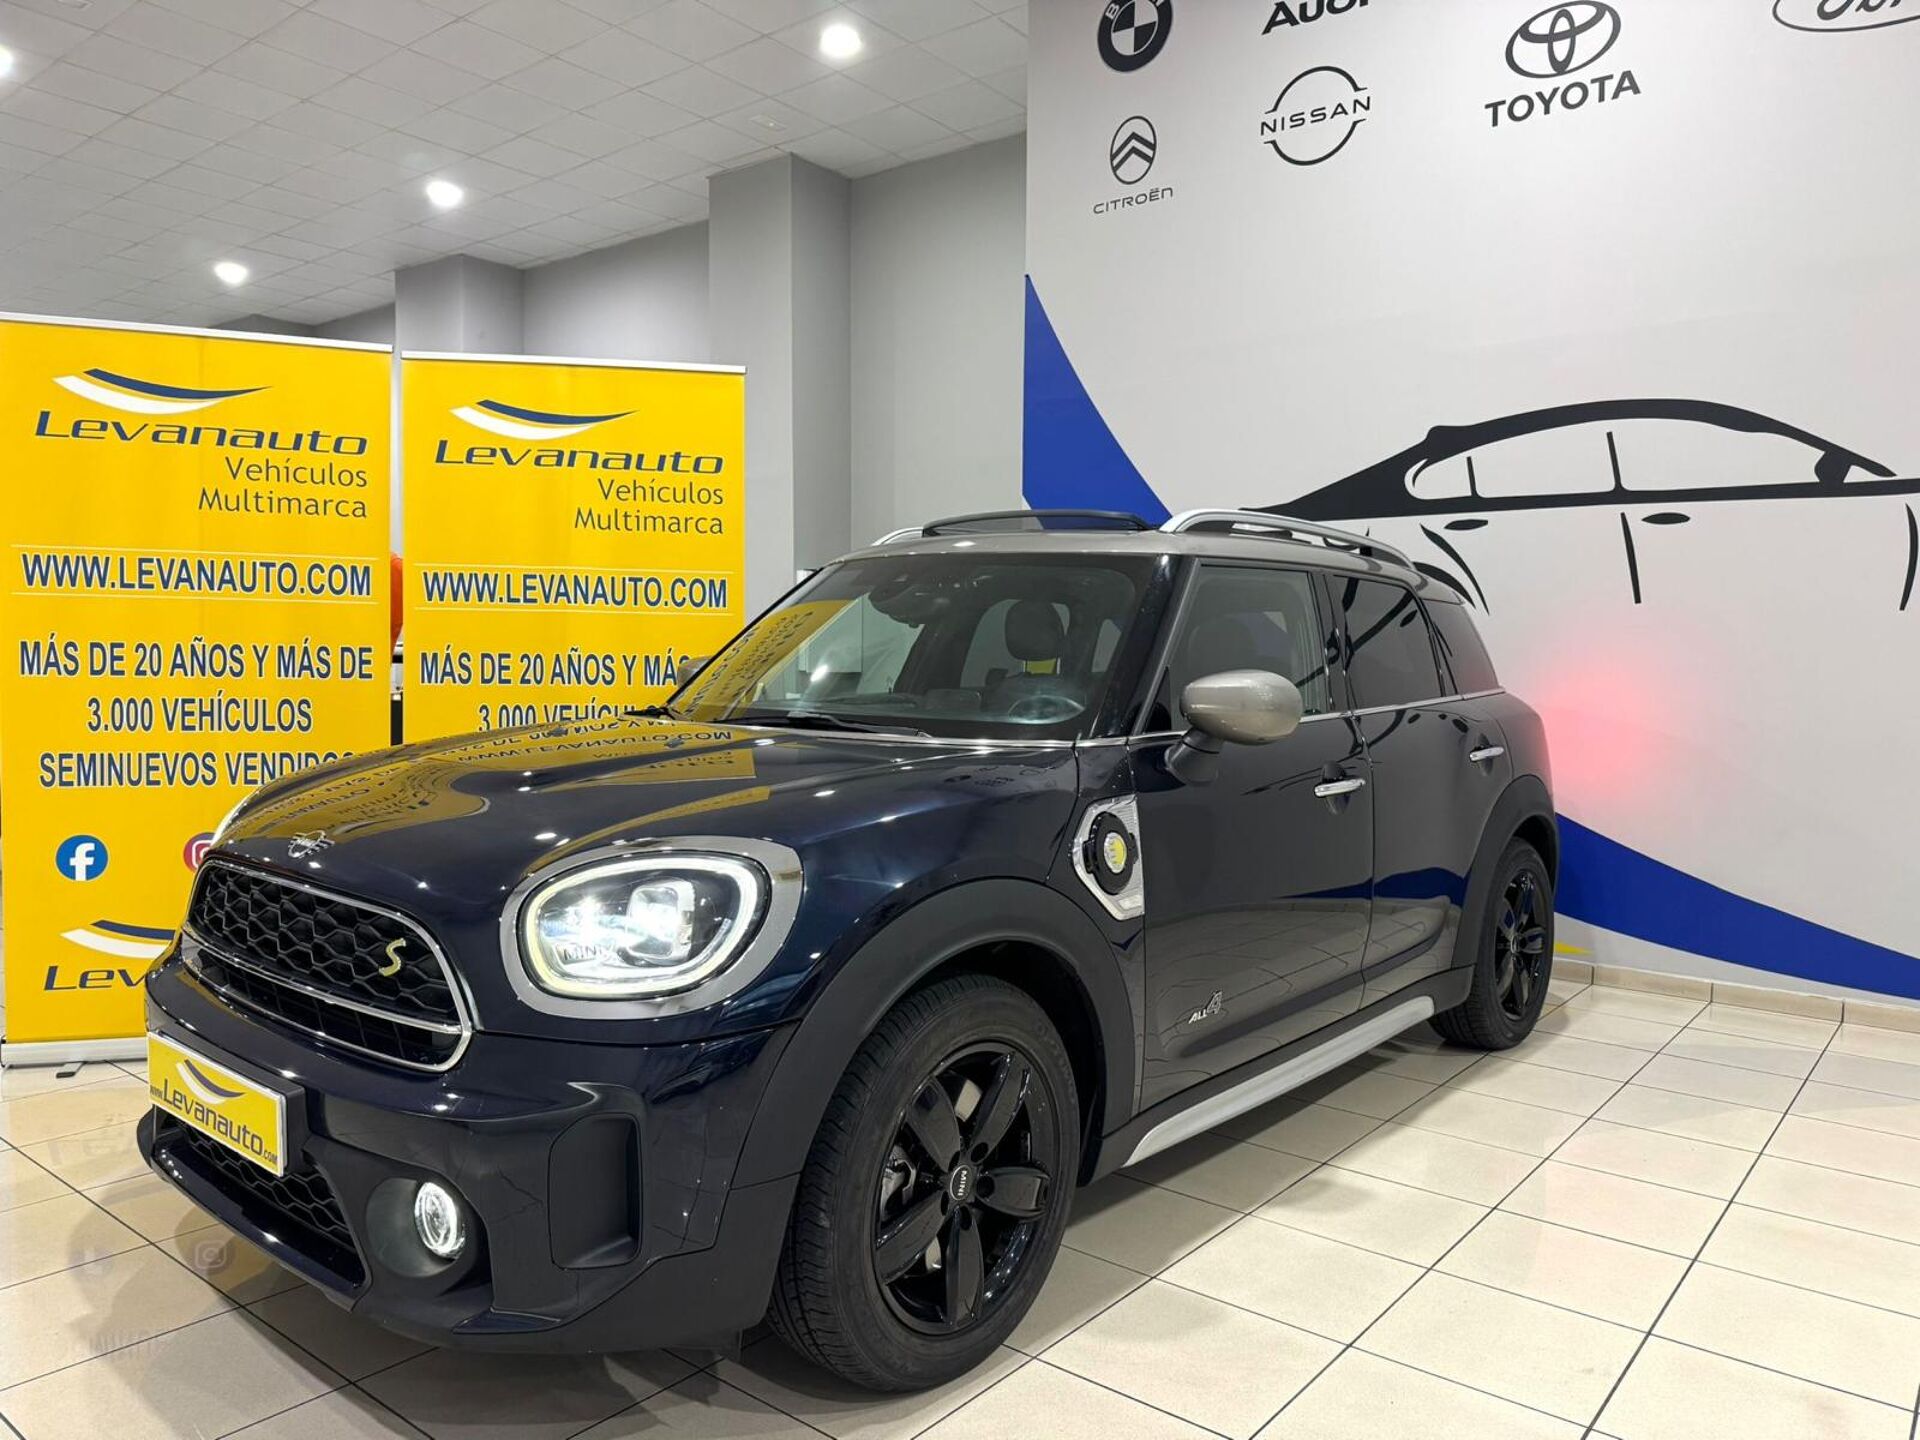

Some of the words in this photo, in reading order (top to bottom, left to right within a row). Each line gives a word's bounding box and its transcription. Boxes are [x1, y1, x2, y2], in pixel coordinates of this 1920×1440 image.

[1261, 96, 1370, 136] NISSAN
[1485, 70, 1641, 127] TOYOTA
[35, 410, 367, 455] Levanauto
[226, 457, 367, 487] Vehículos
[435, 440, 723, 474] Levanauto
[198, 488, 366, 518] Multimarca
[598, 478, 723, 505] Vehículos
[575, 508, 723, 535] Multimarca
[22, 553, 370, 596] WWW.LEVANAUTO.COM
[423, 571, 727, 608] WWW.LEVANAUTO.COM
[20, 633, 80, 676] MÁS
[89, 641, 126, 676] DE
[134, 643, 162, 677] 20
[169, 636, 245, 678] AÑOS
[252, 644, 270, 678] Y
[277, 638, 332, 679] MÁS
[339, 646, 373, 679] DE
[420, 645, 472, 685] MÁS
[480, 652, 512, 685] DE
[519, 653, 545, 686] 20
[550, 647, 616, 686] AÑOS
[622, 654, 637, 686] Y
[644, 648, 690, 686] MÁ
[87, 697, 153, 732] 3.000
[161, 690, 312, 733] VEHÍCULOS
[479, 704, 536, 730] 3000
[40, 752, 217, 788] SEMINUEVOS
[378, 937, 407, 977] S
[957, 1170, 968, 1196] MINI
